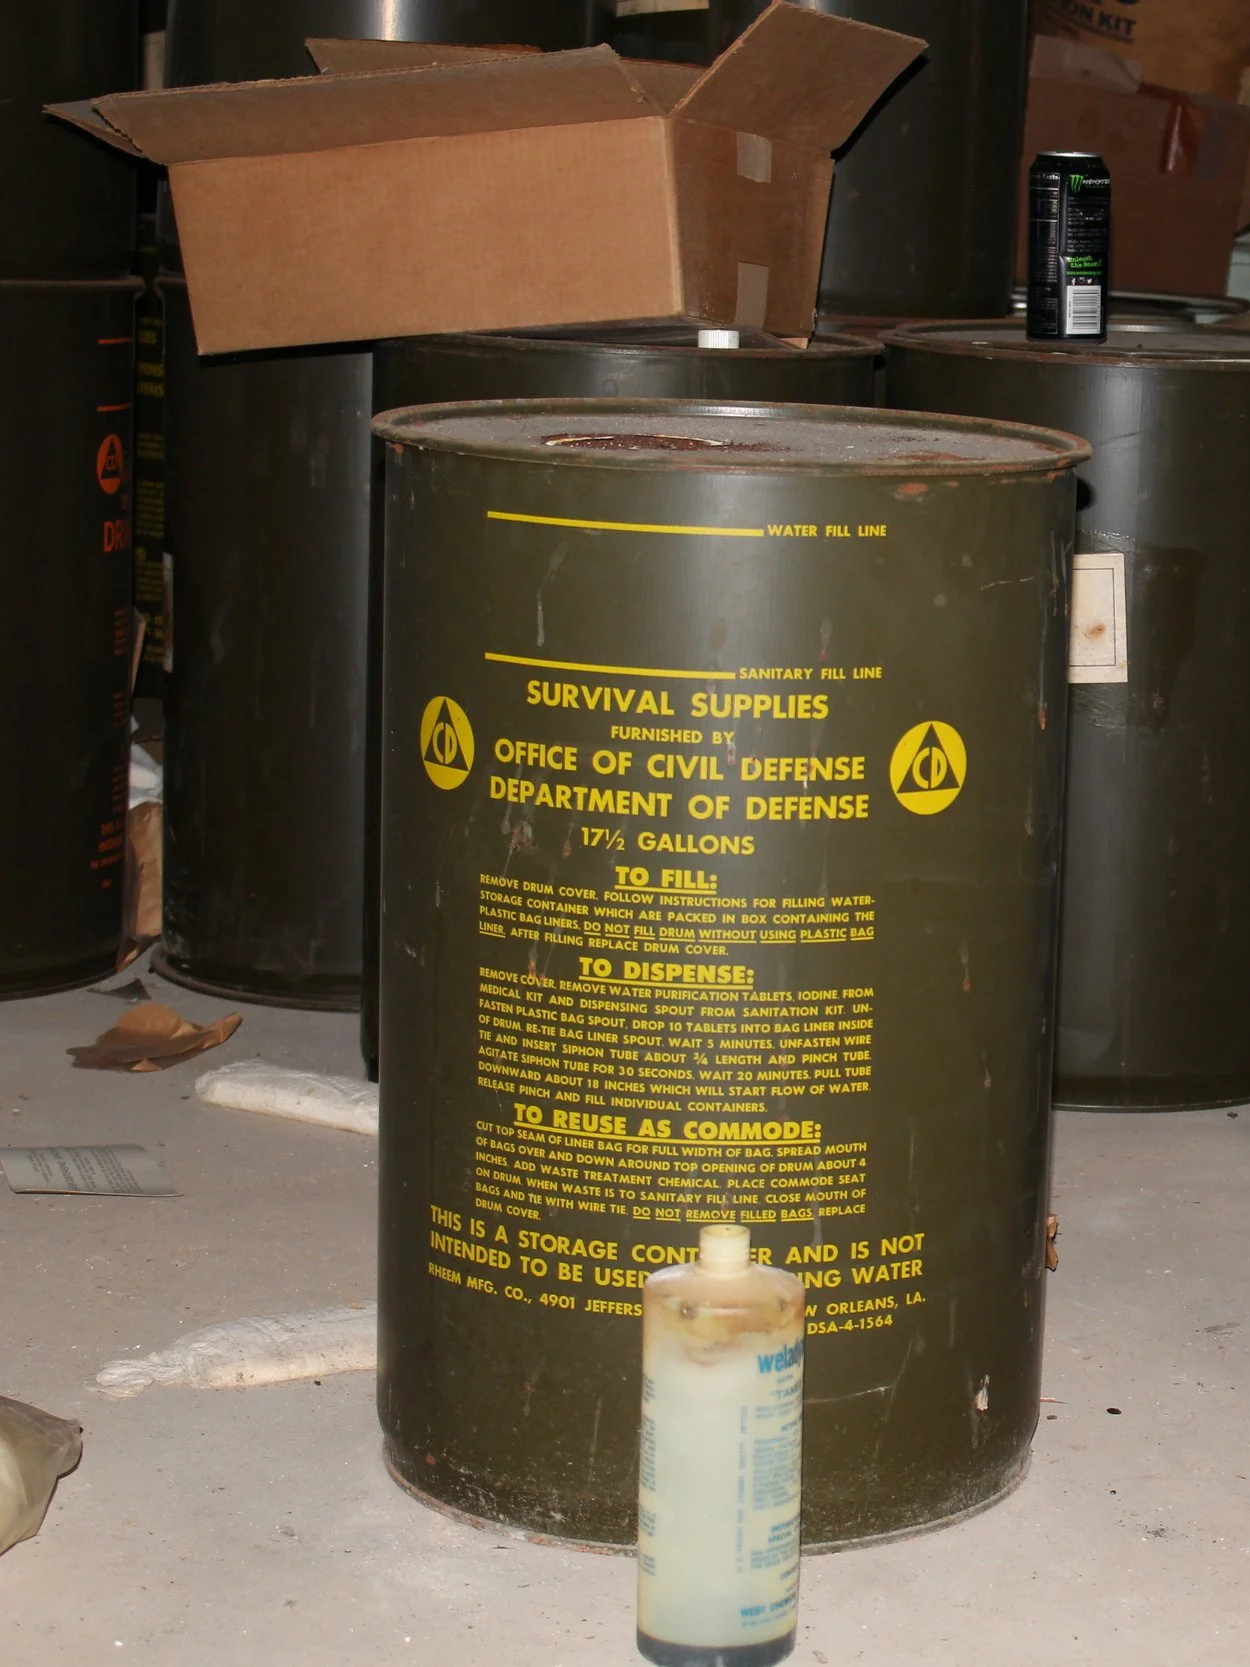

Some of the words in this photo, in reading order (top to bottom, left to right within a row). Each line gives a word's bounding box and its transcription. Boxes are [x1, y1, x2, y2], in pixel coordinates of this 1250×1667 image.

[1098, 10, 1137, 36] KIT
[767, 524, 818, 537] WATER
[825, 525, 851, 537] FILL
[858, 525, 887, 537] LINE
[739, 667, 814, 680] SANITARY
[820, 667, 846, 680] FILL
[852, 666, 882, 679] LINE
[526, 679, 674, 716] SURVIVAL
[690, 692, 828, 719] SUPPLIES
[610, 725, 703, 744] FURNISHED
[712, 730, 733, 745] BY
[494, 737, 578, 771] OFFICE
[592, 749, 632, 776] OF
[646, 753, 724, 780] CIVIL
[740, 756, 865, 781] DEFENSE
[490, 775, 672, 817] DEPARTMENT
[688, 794, 730, 820] OF
[746, 794, 869, 820] DEFENSE
[636, 831, 754, 855] GALLONS
[480, 873, 519, 890] REMOVE
[522, 880, 554, 895] DRUM
[603, 890, 654, 904] FOLLOW
[659, 894, 748, 908] INSTRUCTIONS
[752, 898, 776, 908] FOR
[782, 896, 826, 908] FILLING
[614, 865, 650, 889] TO
[660, 868, 718, 890] FILL:
[578, 956, 612, 978] TO
[623, 960, 754, 984] DISPENSE:
[513, 1102, 543, 1129] TO
[552, 1108, 626, 1139] REUSE
[637, 1118, 672, 1142] AS
[682, 1120, 822, 1144] COMMODE:
[430, 1204, 462, 1231] THIS
[470, 1217, 486, 1238] IS
[494, 1224, 508, 1244] A
[518, 1229, 618, 1260] STORAGE
[784, 1244, 838, 1264] AND
[850, 1240, 870, 1260] IS
[880, 1232, 925, 1256] NOT
[430, 1231, 511, 1269] INTENDED
[519, 1255, 548, 1277] TO
[558, 1261, 583, 1282] BE
[850, 1258, 922, 1285] WATER
[428, 1262, 462, 1285] RHEEM
[466, 1275, 498, 1295] MFG.
[504, 1285, 532, 1303] CO.,
[538, 1292, 576, 1310] 4901
[584, 1299, 642, 1317] JEFFERS
[825, 1295, 898, 1315] ORLEANS,
[906, 1291, 926, 1305] LA.
[806, 1314, 893, 1335] DSA-4-1564
